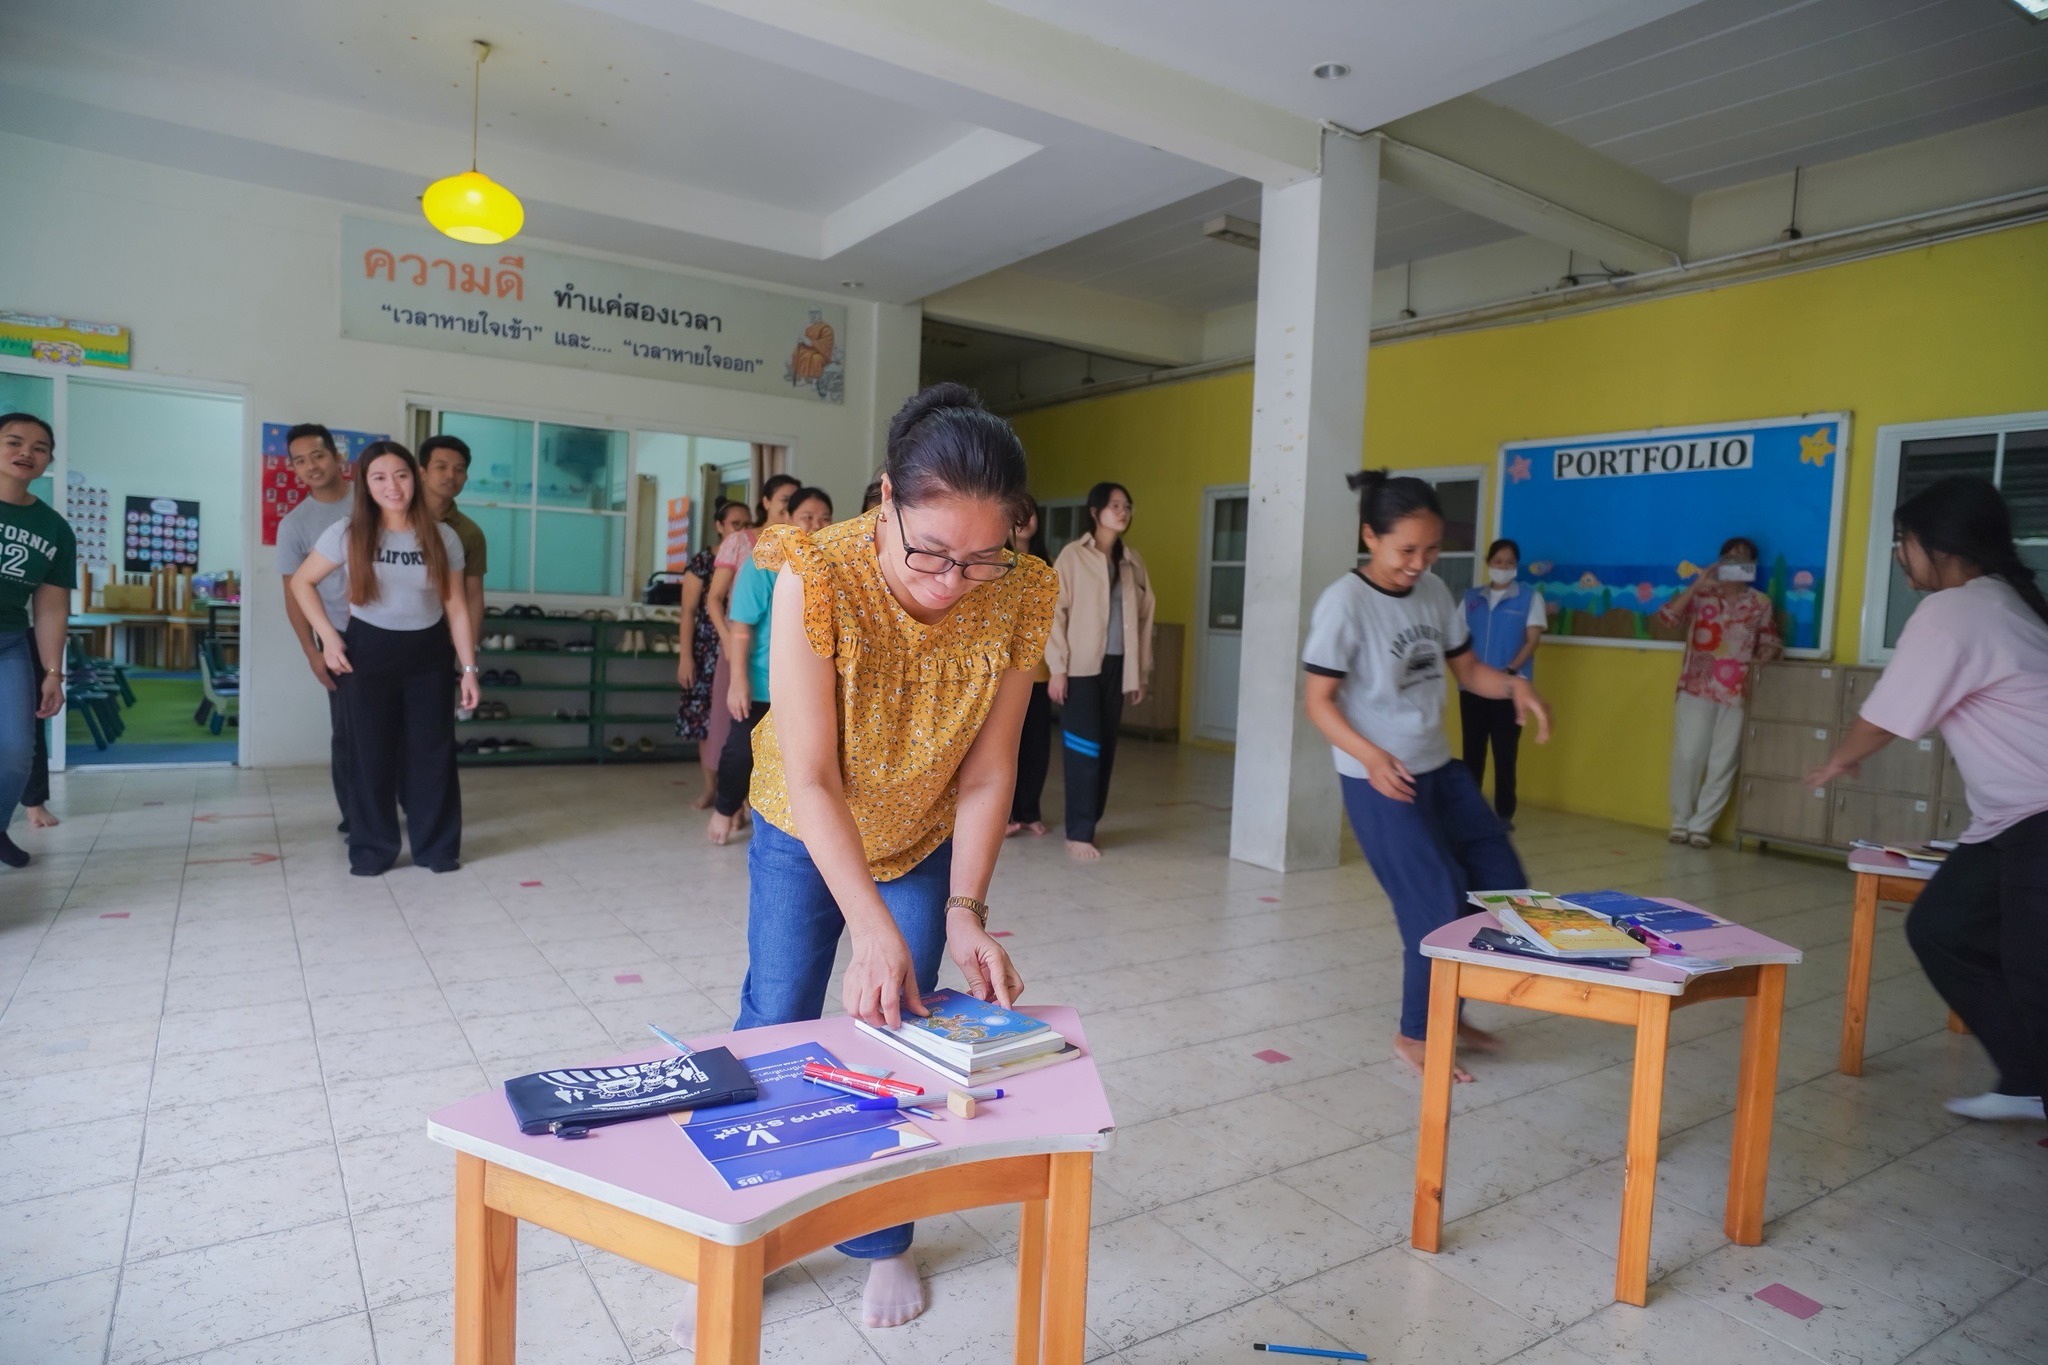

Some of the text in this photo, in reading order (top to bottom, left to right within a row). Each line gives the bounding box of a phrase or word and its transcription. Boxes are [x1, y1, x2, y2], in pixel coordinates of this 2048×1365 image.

[364, 248, 722, 333] ความดี ทำแค่สองเวลา
[1556, 439, 1748, 478] PORTFOLIO
[0, 542, 29, 578] 2
[722, 1119, 785, 1136] STAR
[746, 1130, 781, 1146] V
[737, 1176, 763, 1187] IBS
